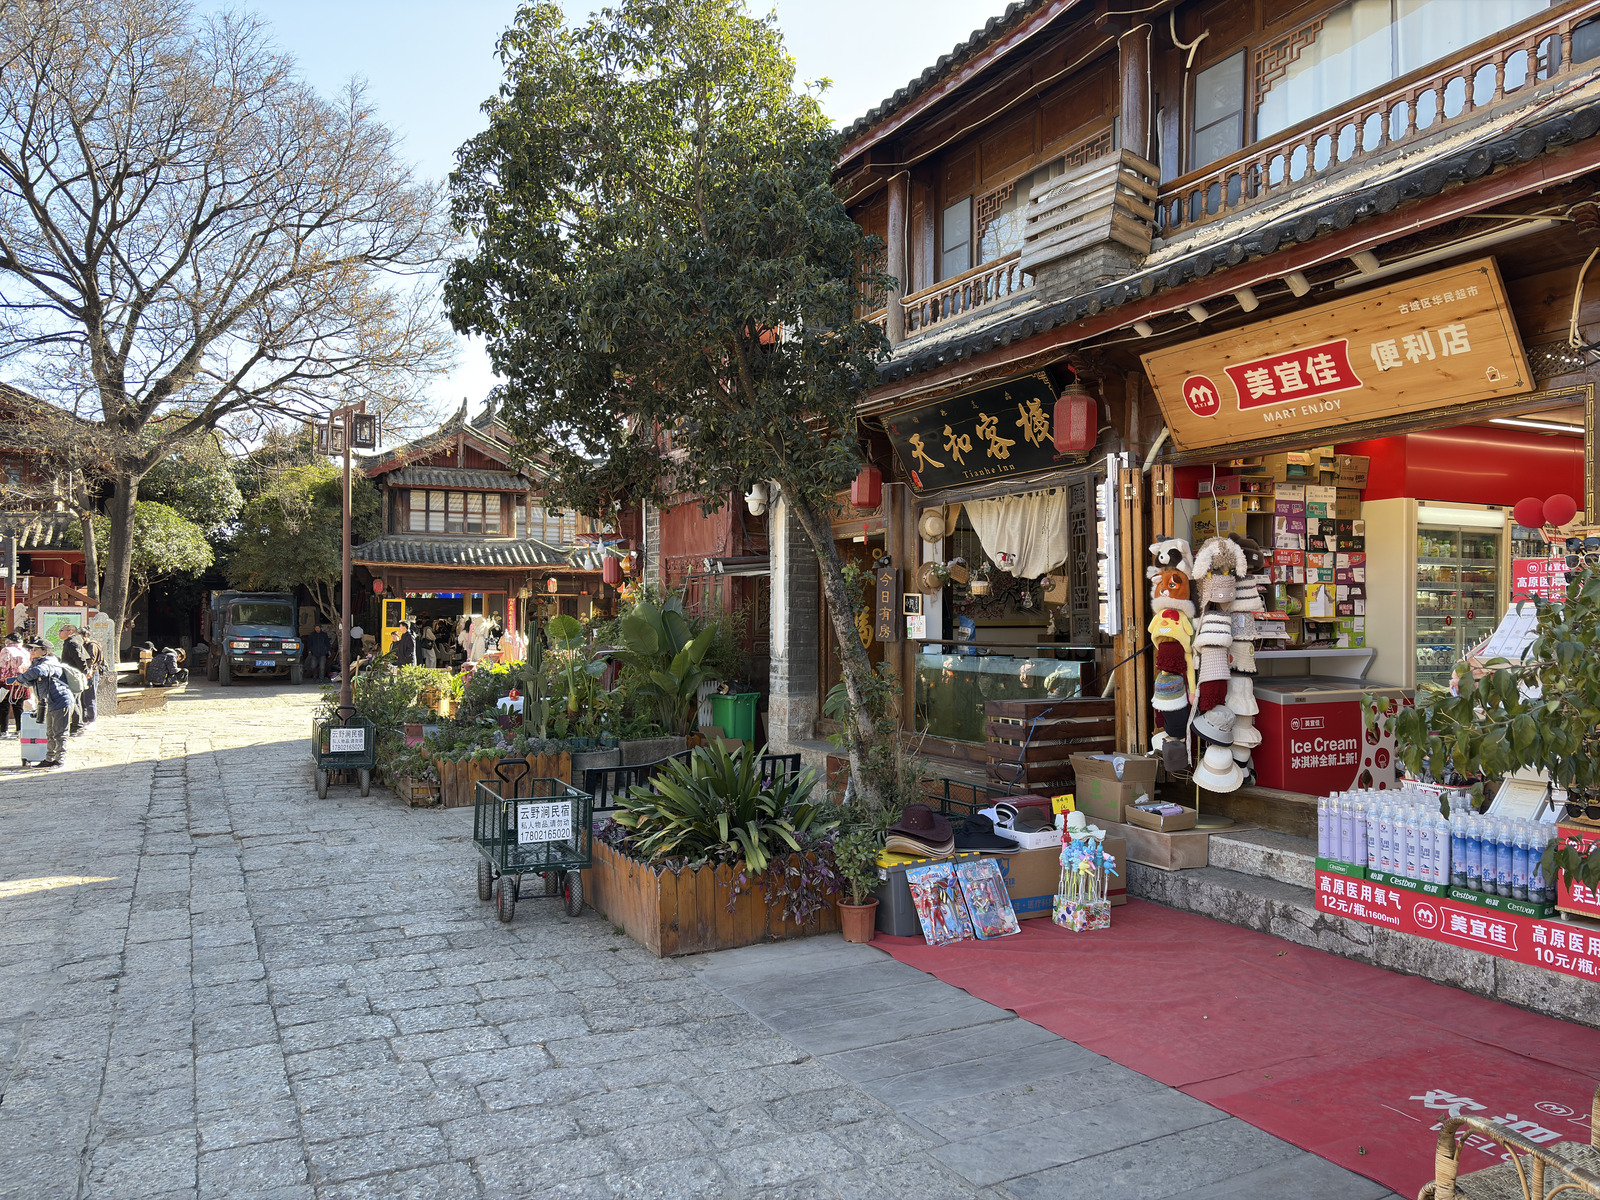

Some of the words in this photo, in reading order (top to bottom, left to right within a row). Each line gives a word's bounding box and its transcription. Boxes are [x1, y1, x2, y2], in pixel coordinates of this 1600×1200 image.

[1398, 285, 1479, 314] 古城区华民超市
[1370, 323, 1472, 371] 便利店
[1243, 353, 1341, 399] 美宜佳
[1262, 408, 1297, 423] MART
[1302, 399, 1342, 416] ENJOY
[962, 465, 996, 479] Tianhe
[997, 463, 1016, 472] Inn
[879, 572, 893, 638] 今日有房
[1305, 719, 1320, 727] 美宜佳
[1291, 738, 1312, 754] Ice
[1314, 737, 1357, 752] Cream
[521, 828, 571, 841] 17802165020
[1319, 875, 1402, 910] 高原医用氧气
[1321, 894, 1400, 926] 12元/瓶(1600ml)
[1450, 914, 1507, 944] 美宜佳
